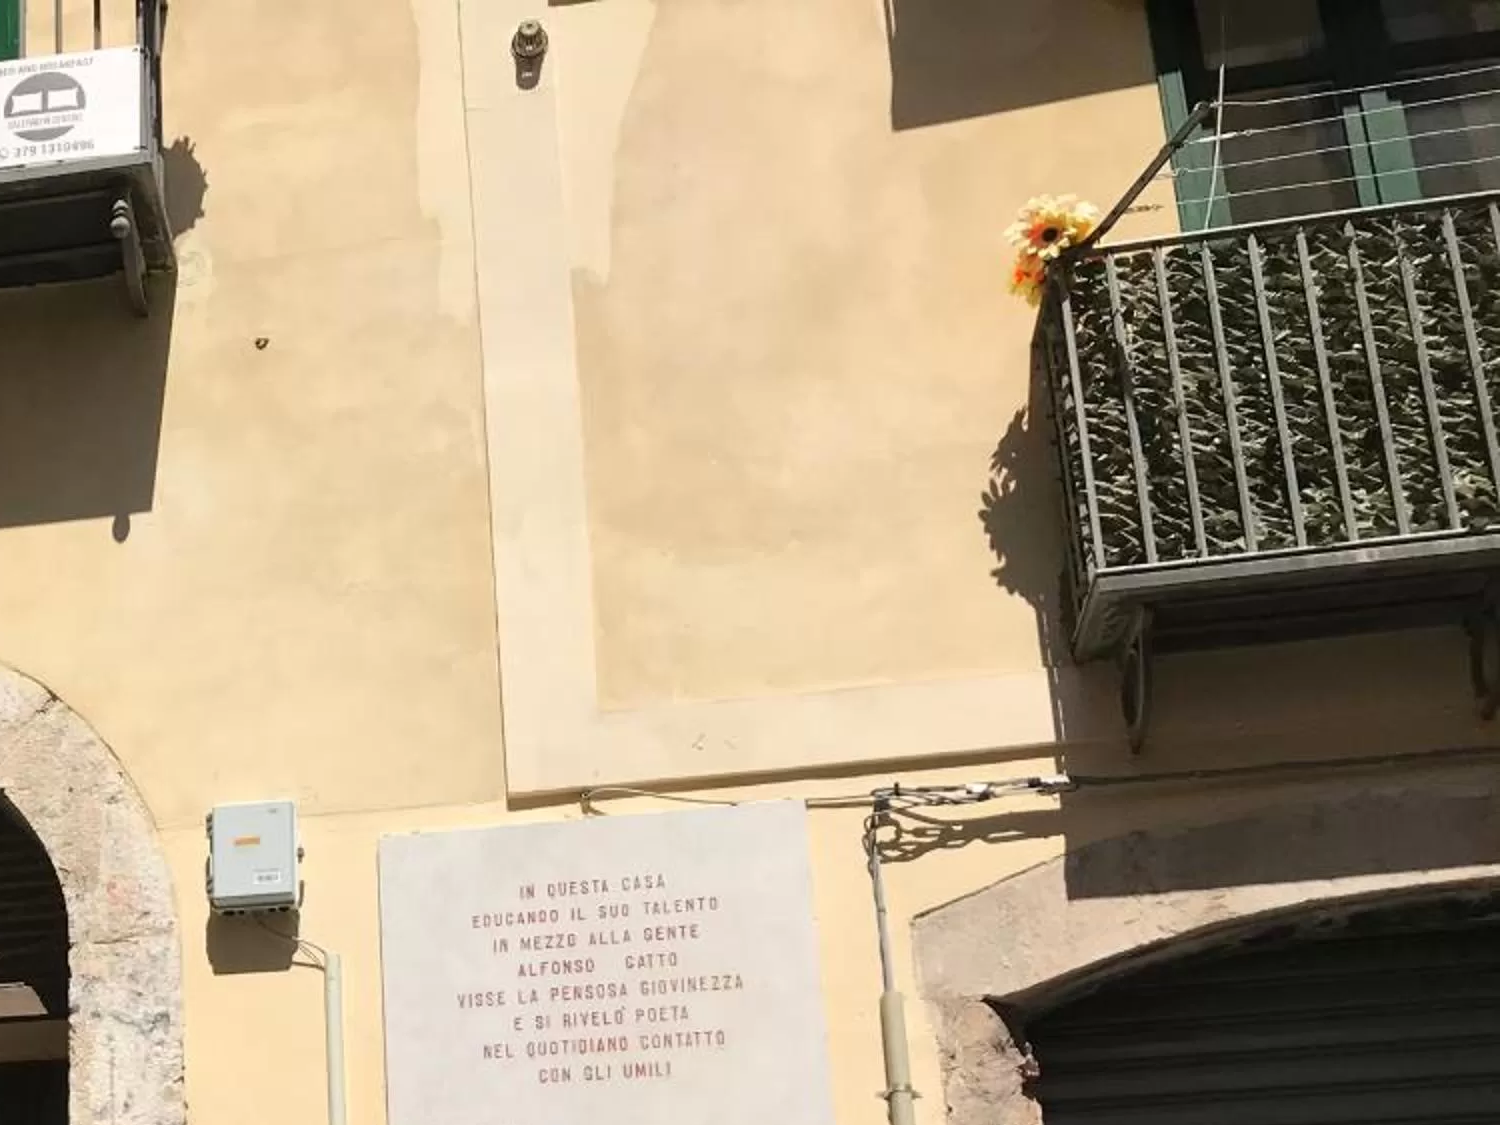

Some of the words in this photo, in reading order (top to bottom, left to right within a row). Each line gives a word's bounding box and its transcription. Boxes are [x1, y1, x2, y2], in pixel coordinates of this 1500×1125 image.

[519, 883, 535, 900] IN
[547, 879, 609, 898] QUESTA
[621, 873, 665, 892] CASA
[472, 909, 559, 928] EDUCANDO
[570, 907, 588, 922] IL
[597, 904, 630, 919] SUO
[643, 896, 718, 915] TALENTO
[493, 938, 508, 956] IN
[520, 933, 577, 951] MEZZO
[588, 929, 632, 946] ALLA
[644, 924, 700, 943] GENTE
[518, 957, 595, 977] ALFONSO
[624, 952, 678, 970] GATTO
[457, 991, 506, 1009] VISSE
[518, 988, 539, 1005] LA
[549, 982, 628, 1002] PENSOSA
[639, 974, 743, 996] GIOVINEZZA
[513, 1016, 524, 1032] E
[535, 1015, 551, 1030] SI
[635, 1005, 688, 1024] POETA
[483, 1043, 515, 1059] NEL
[526, 1036, 628, 1060] QUOTIDIANO
[638, 1029, 725, 1051] CONTATTO
[538, 1066, 571, 1084] CON
[583, 1064, 611, 1081] GLI
[621, 1061, 671, 1079] UMILI
